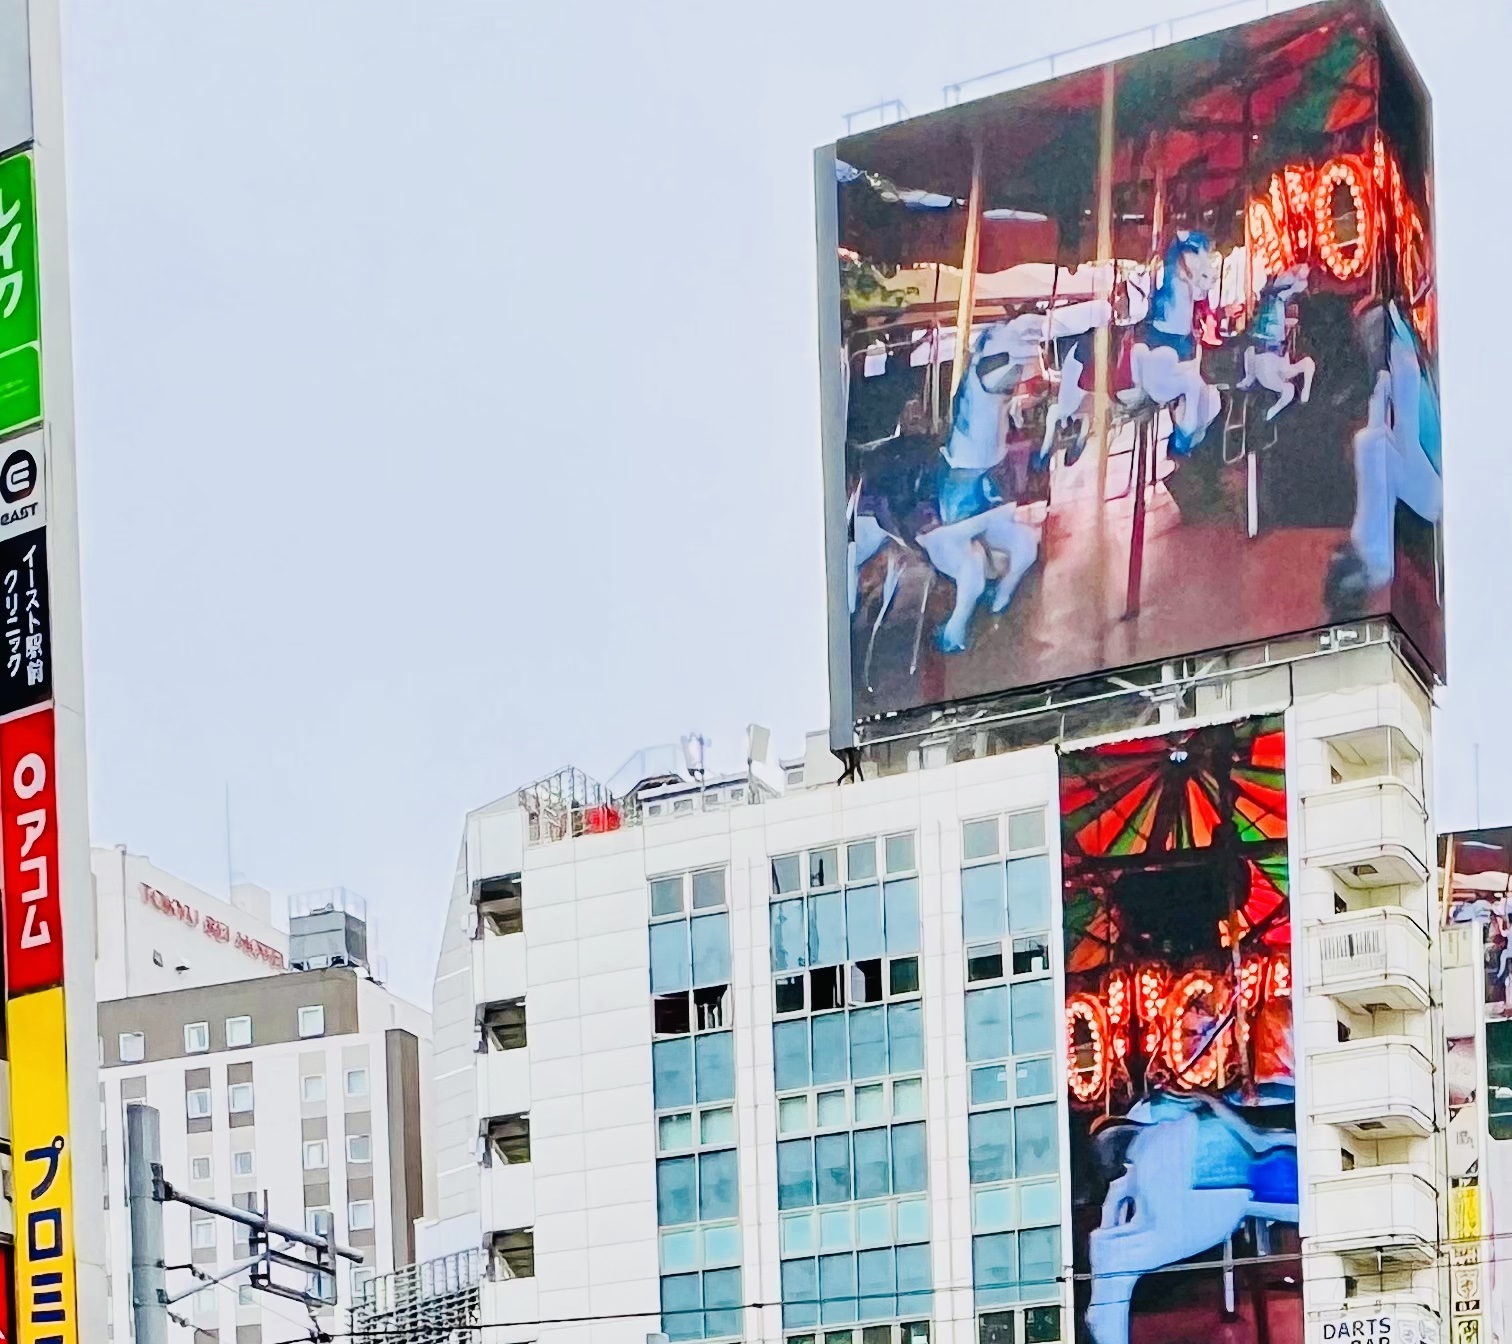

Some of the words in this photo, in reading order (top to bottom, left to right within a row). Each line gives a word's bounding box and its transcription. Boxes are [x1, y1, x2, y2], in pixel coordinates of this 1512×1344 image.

[4, 570, 22, 678] クリニック
[17, 811, 52, 949] アコム
[1323, 1317, 1392, 1341] DARTS
